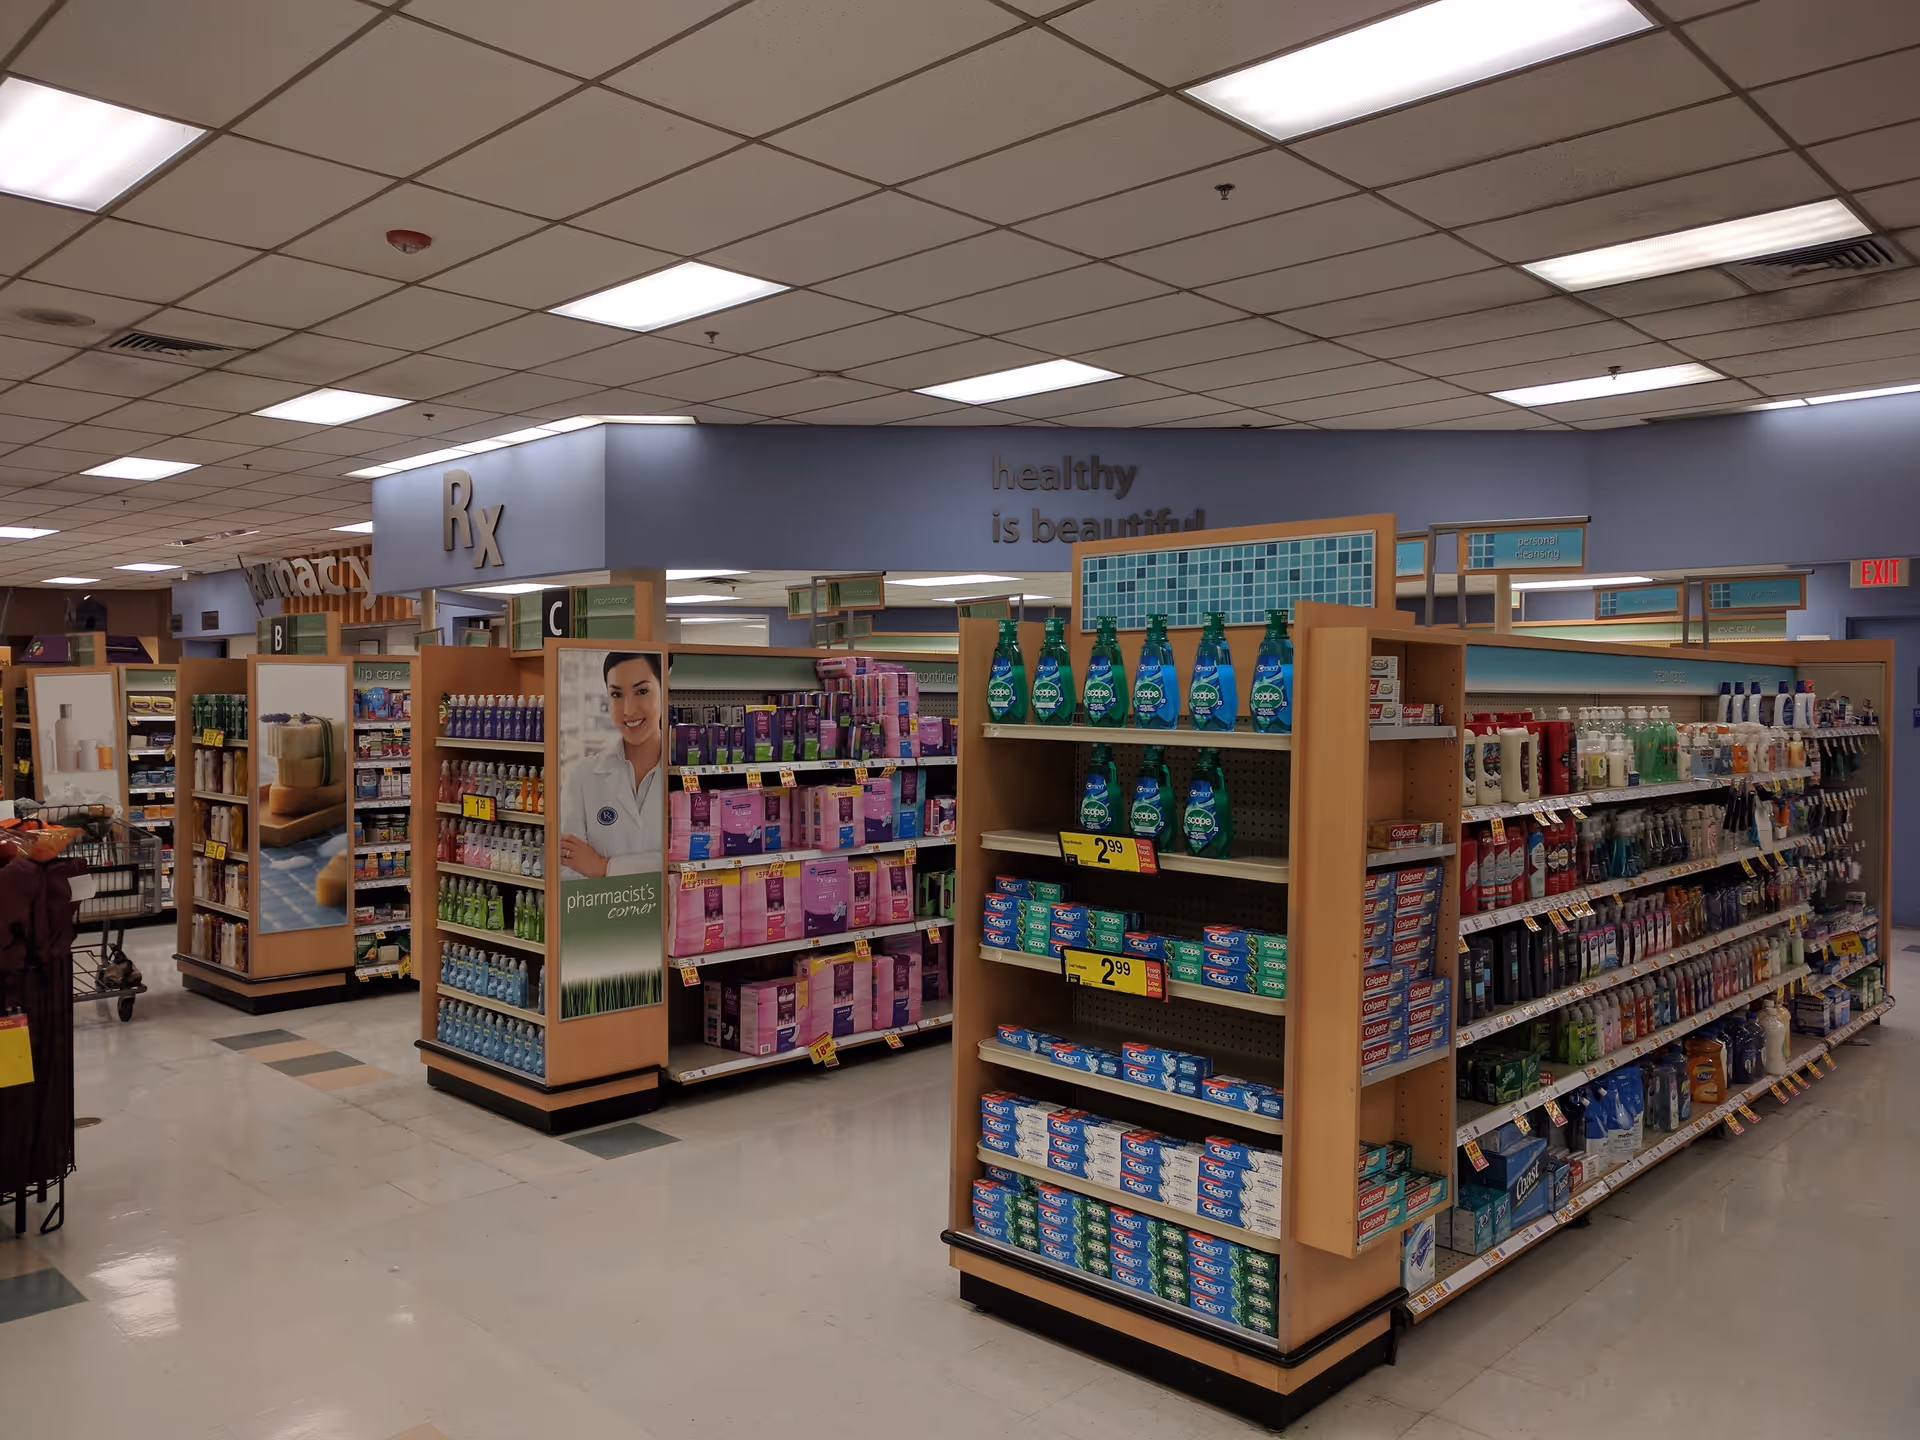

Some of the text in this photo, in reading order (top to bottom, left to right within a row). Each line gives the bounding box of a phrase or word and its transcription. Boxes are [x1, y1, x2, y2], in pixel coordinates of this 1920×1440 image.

[992, 455, 1137, 500] healthy
[443, 469, 504, 569] Rx
[992, 509, 1020, 543] is
[1517, 534, 1559, 547] personal
[1515, 548, 1560, 560] cleansing
[1861, 559, 1900, 585] EXIT
[549, 601, 563, 636] C
[1736, 625, 1756, 633] care
[274, 625, 283, 651] B
[358, 666, 372, 682] lip
[376, 670, 401, 680] care
[909, 668, 957, 683] continen
[1403, 706, 1422, 716] Colgate
[1392, 828, 1418, 838] Colgate
[1400, 872, 1423, 884] Colgate
[567, 884, 655, 913] pharmacist's
[1400, 894, 1422, 906] Colgate
[607, 902, 657, 919] corner
[1397, 918, 1418, 930] Colgate
[1394, 941, 1416, 952] Colgate
[1366, 974, 1389, 987] Colgate
[1410, 986, 1432, 999] Colgate
[1364, 998, 1386, 1012] Colgate
[1410, 1009, 1432, 1022] Colgate
[1365, 1022, 1388, 1036] Colgate
[1409, 1033, 1430, 1046] Colgate
[1364, 1047, 1387, 1061] Colgate
[1516, 1160, 1540, 1200] Coast
[1360, 1190, 1384, 1207] Colgate
[1408, 1190, 1428, 1206] Colgate
[1362, 1214, 1385, 1230] Colgate
